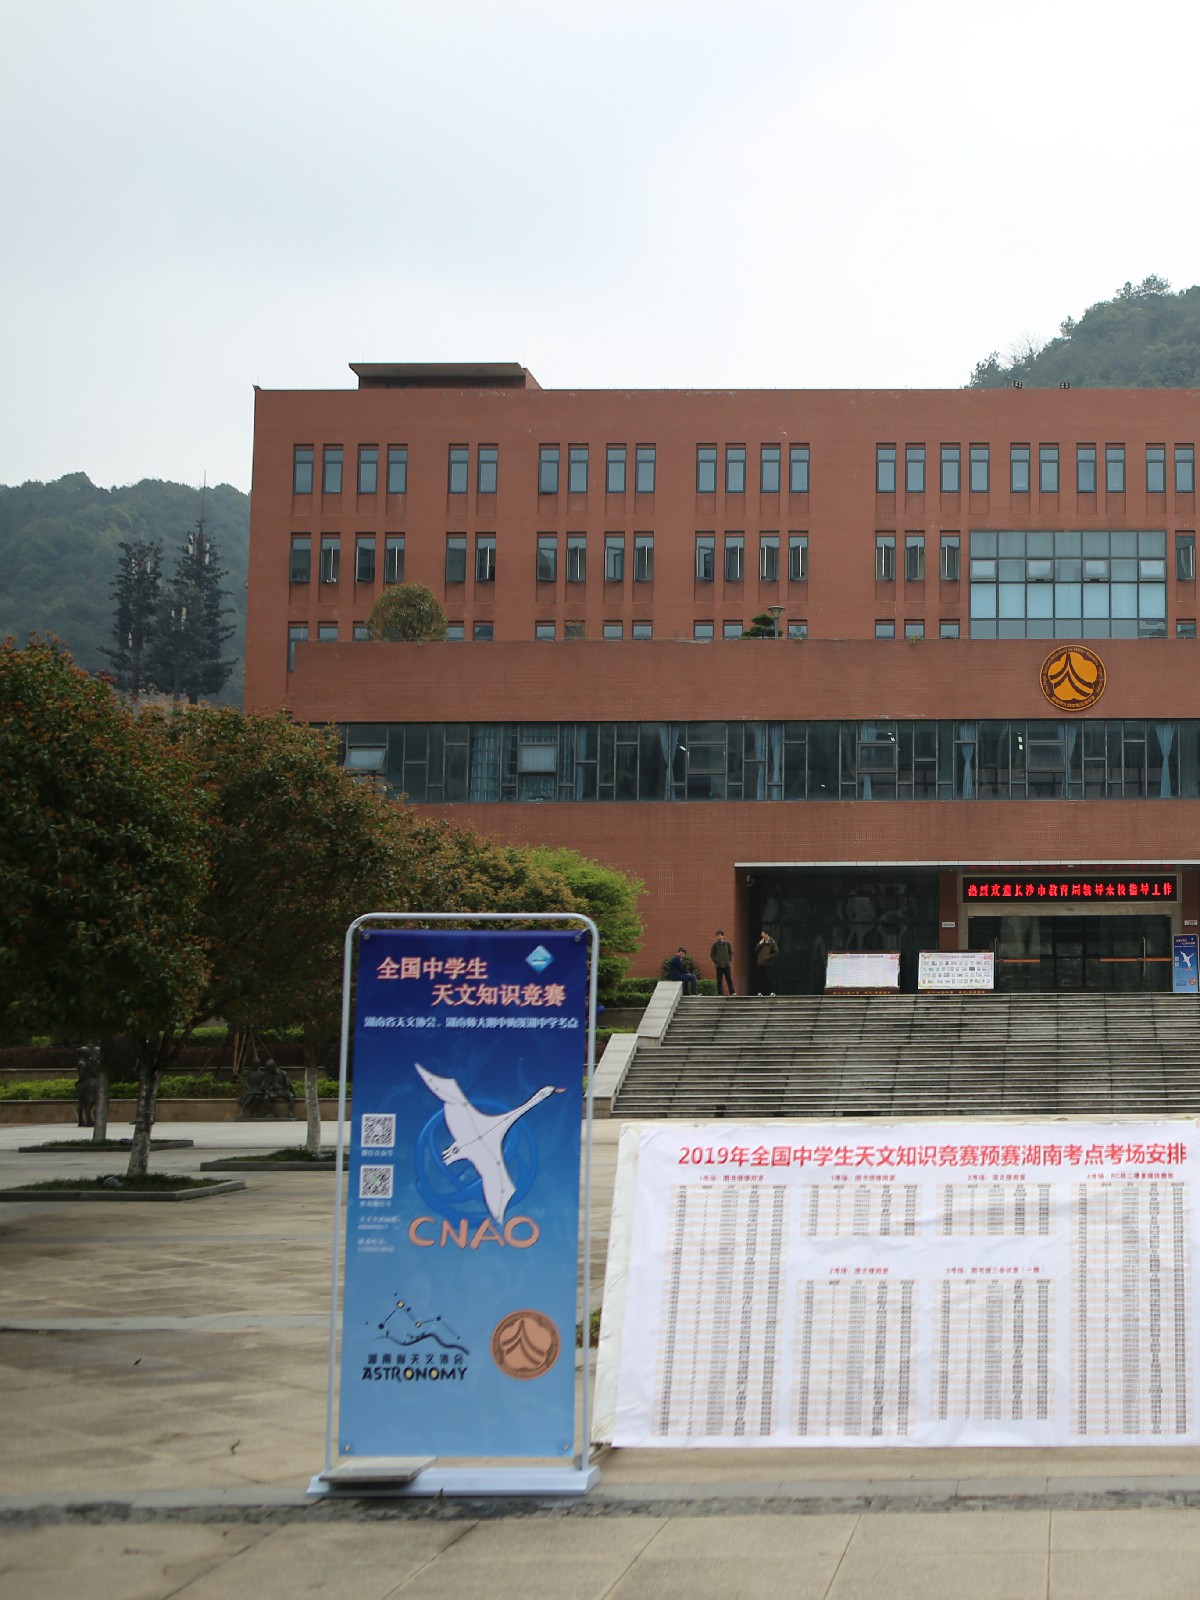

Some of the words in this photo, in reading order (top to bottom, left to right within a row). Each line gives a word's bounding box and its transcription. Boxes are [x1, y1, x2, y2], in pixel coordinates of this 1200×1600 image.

[968, 882, 1172, 897] 热烈欢迎长沙市教育局领导来校指导工作
[376, 956, 489, 980] 全国中学生
[432, 983, 566, 1007] 天文知识竞赛
[678, 1142, 1188, 1168] 2019年全国中学生天文知识竞赛预赛湖南考点考场安排
[409, 1216, 540, 1250] CNAO
[361, 1366, 468, 1382] ASTRONOMY
